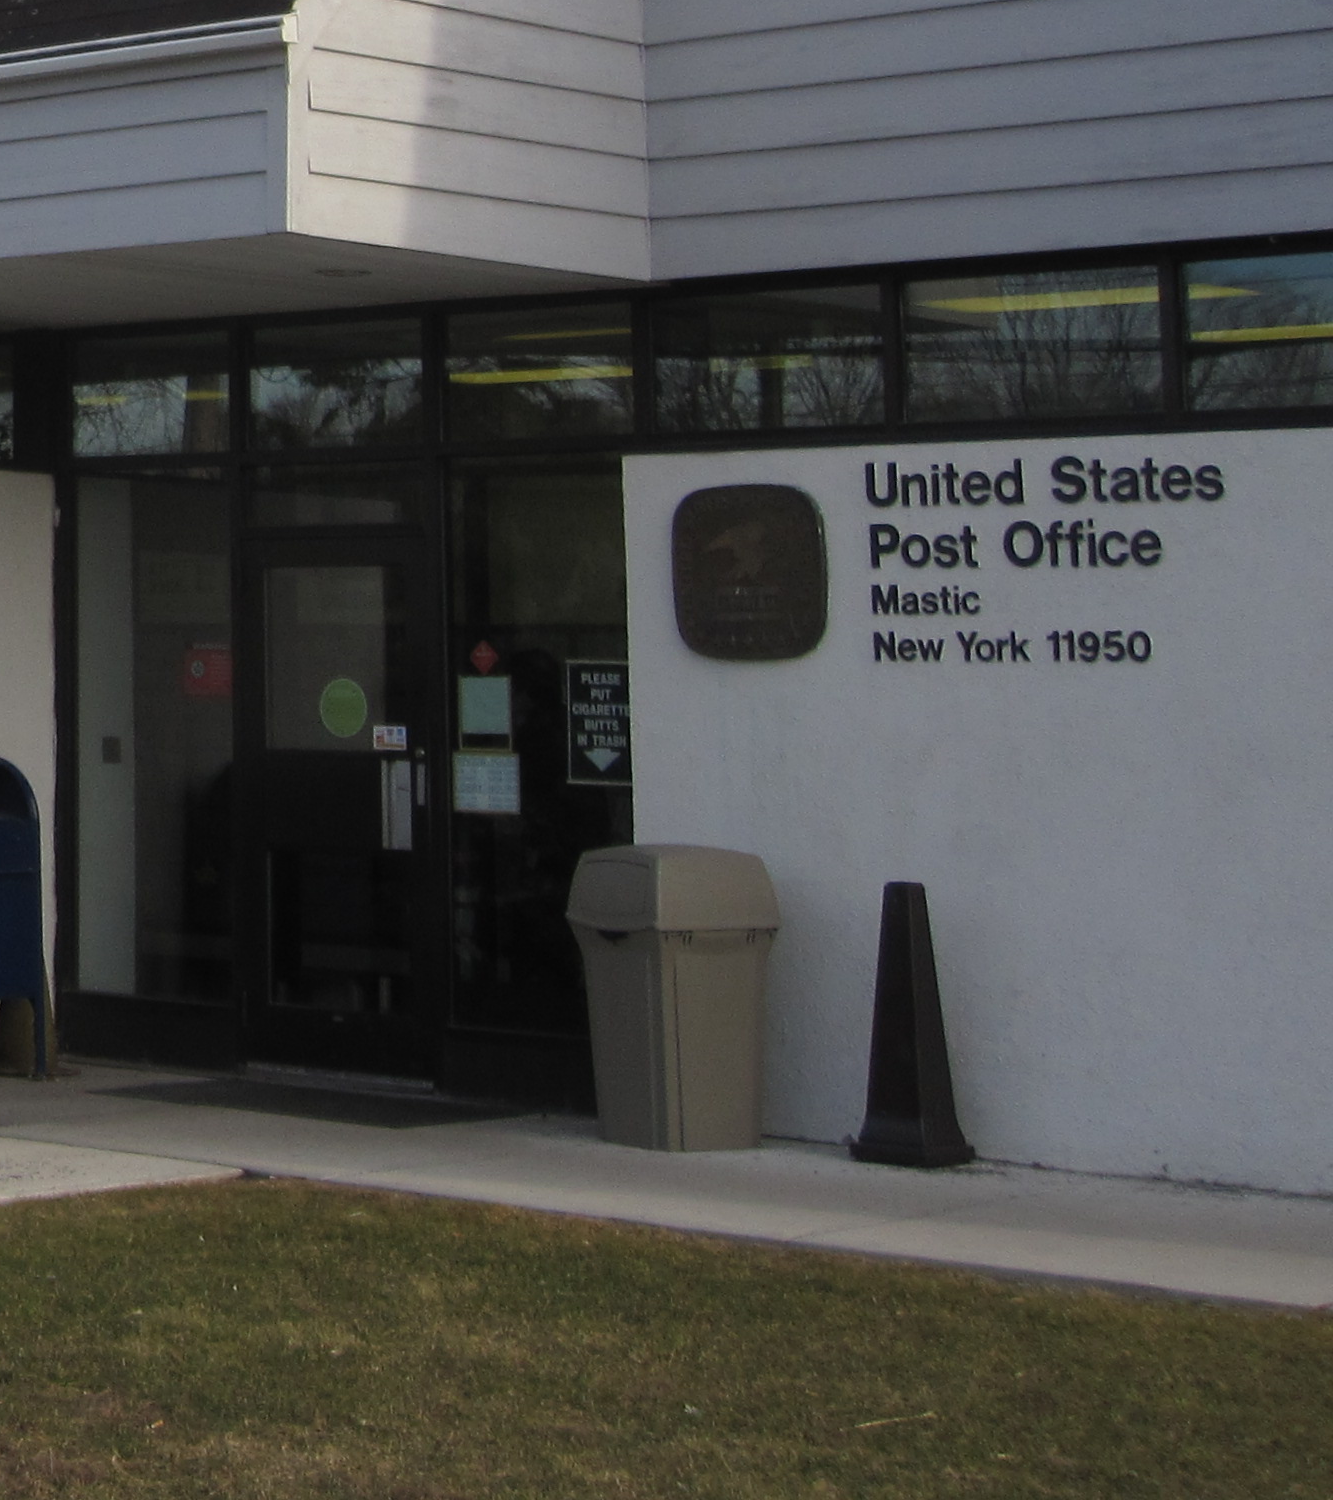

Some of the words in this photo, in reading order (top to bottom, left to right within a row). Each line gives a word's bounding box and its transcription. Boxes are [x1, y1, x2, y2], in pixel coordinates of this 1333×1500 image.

[864, 458, 1026, 509] United
[1050, 455, 1226, 504] States
[868, 522, 980, 570] Post
[1003, 518, 1164, 569] Office
[870, 583, 982, 616] Mastic
[873, 630, 945, 664] New
[955, 630, 1031, 663] York
[1047, 629, 1152, 664] 11950
[581, 673, 621, 685] PLEASE
[590, 687, 612, 701] PUT
[584, 720, 619, 731] BUTTS
[577, 734, 587, 747] IN
[592, 734, 626, 747] TRASH
